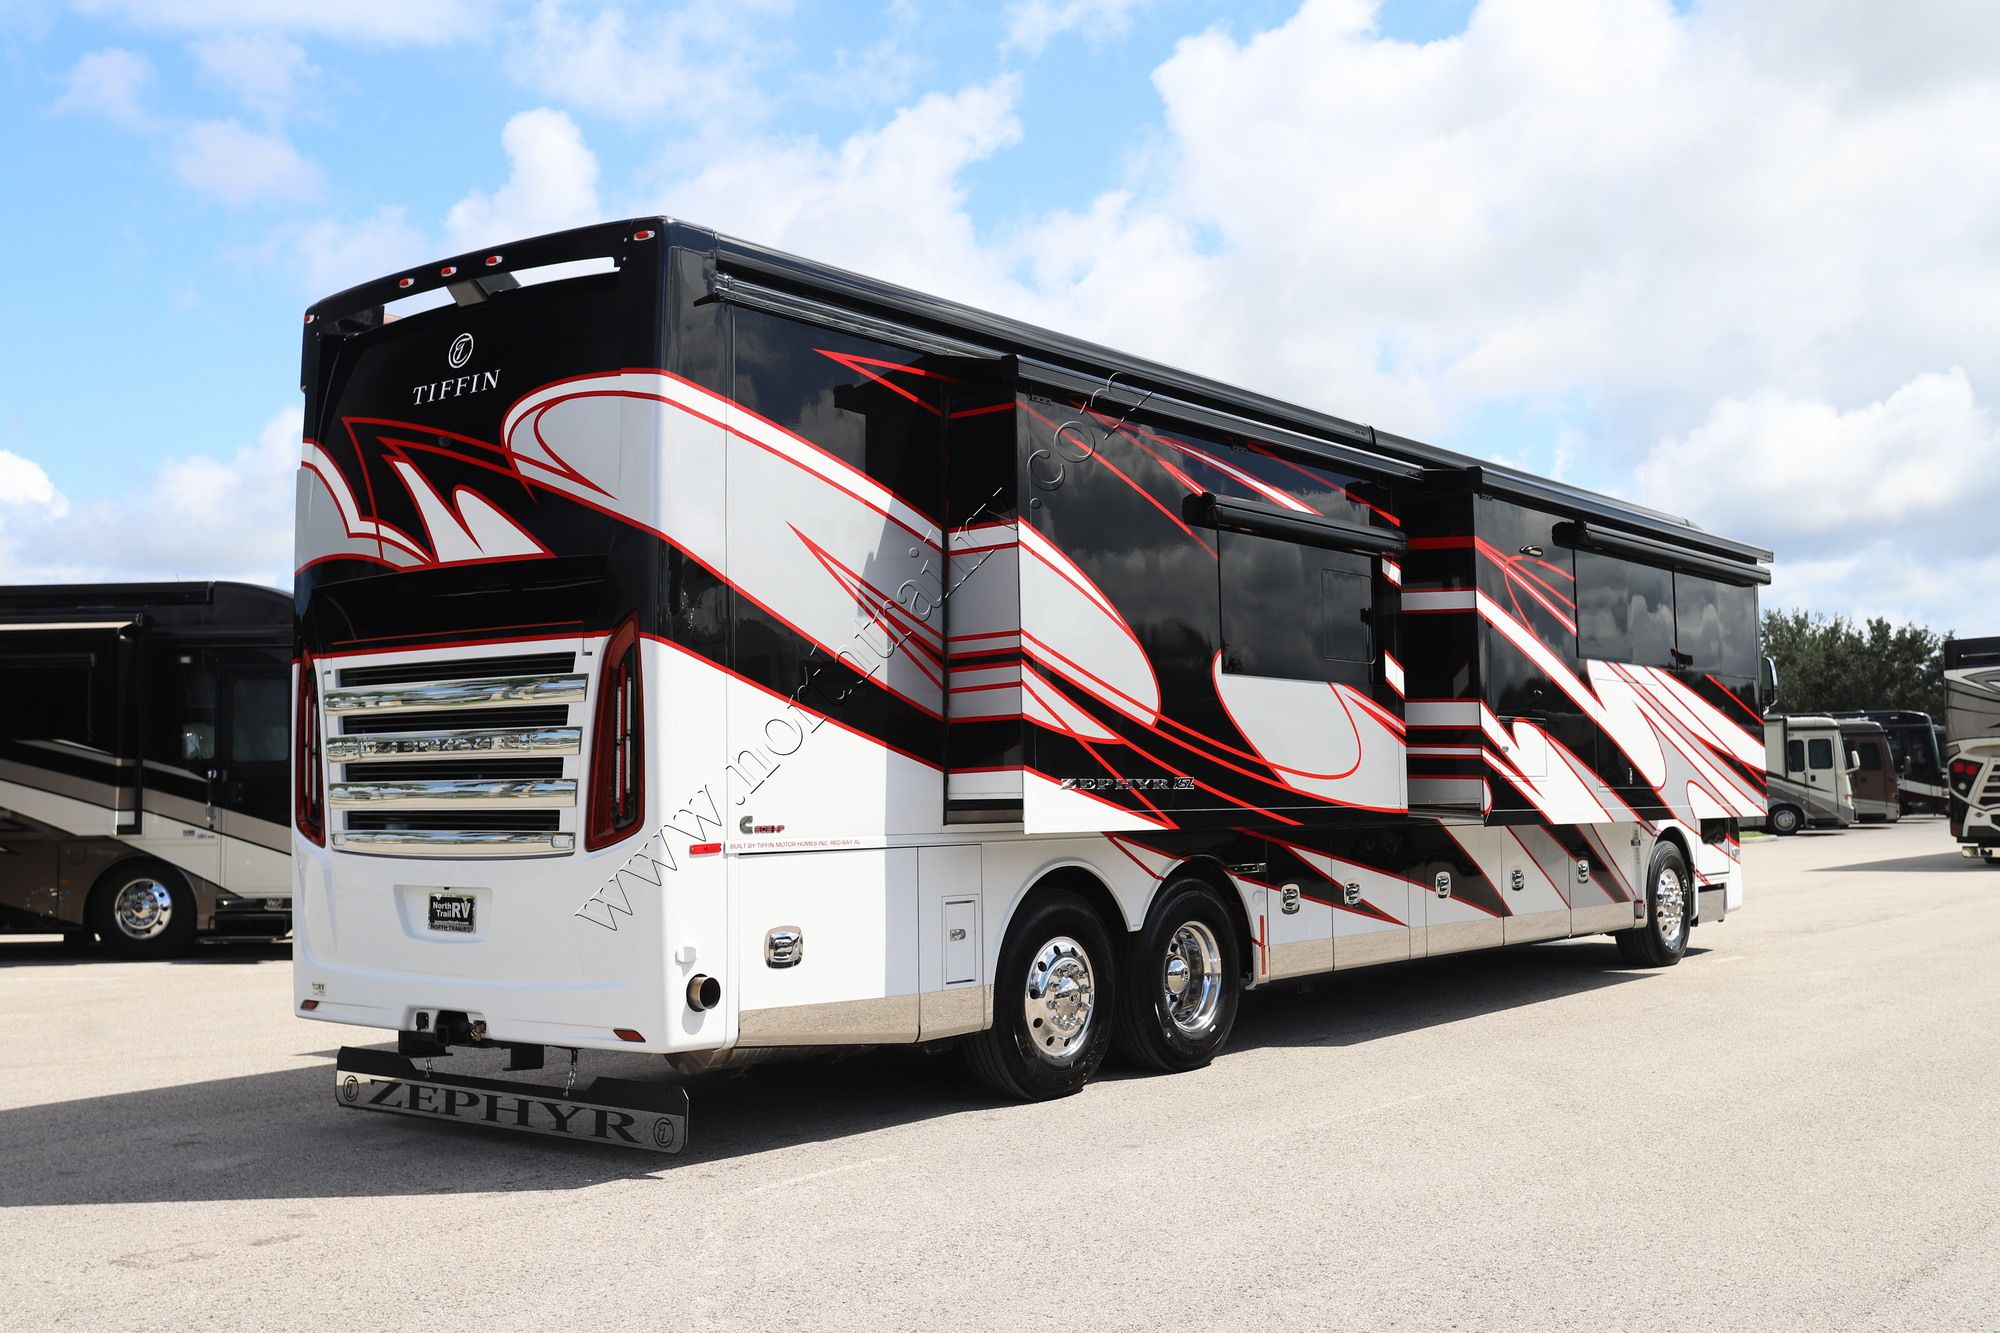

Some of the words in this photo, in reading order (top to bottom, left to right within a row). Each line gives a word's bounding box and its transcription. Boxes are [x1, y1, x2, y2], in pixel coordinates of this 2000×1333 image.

[413, 369, 501, 405] TIFFIN
[1060, 778, 1171, 790] ZEPHYR
[432, 901, 451, 909] North
[452, 902, 471, 918] RV
[367, 1078, 643, 1145] ZEPHYR
